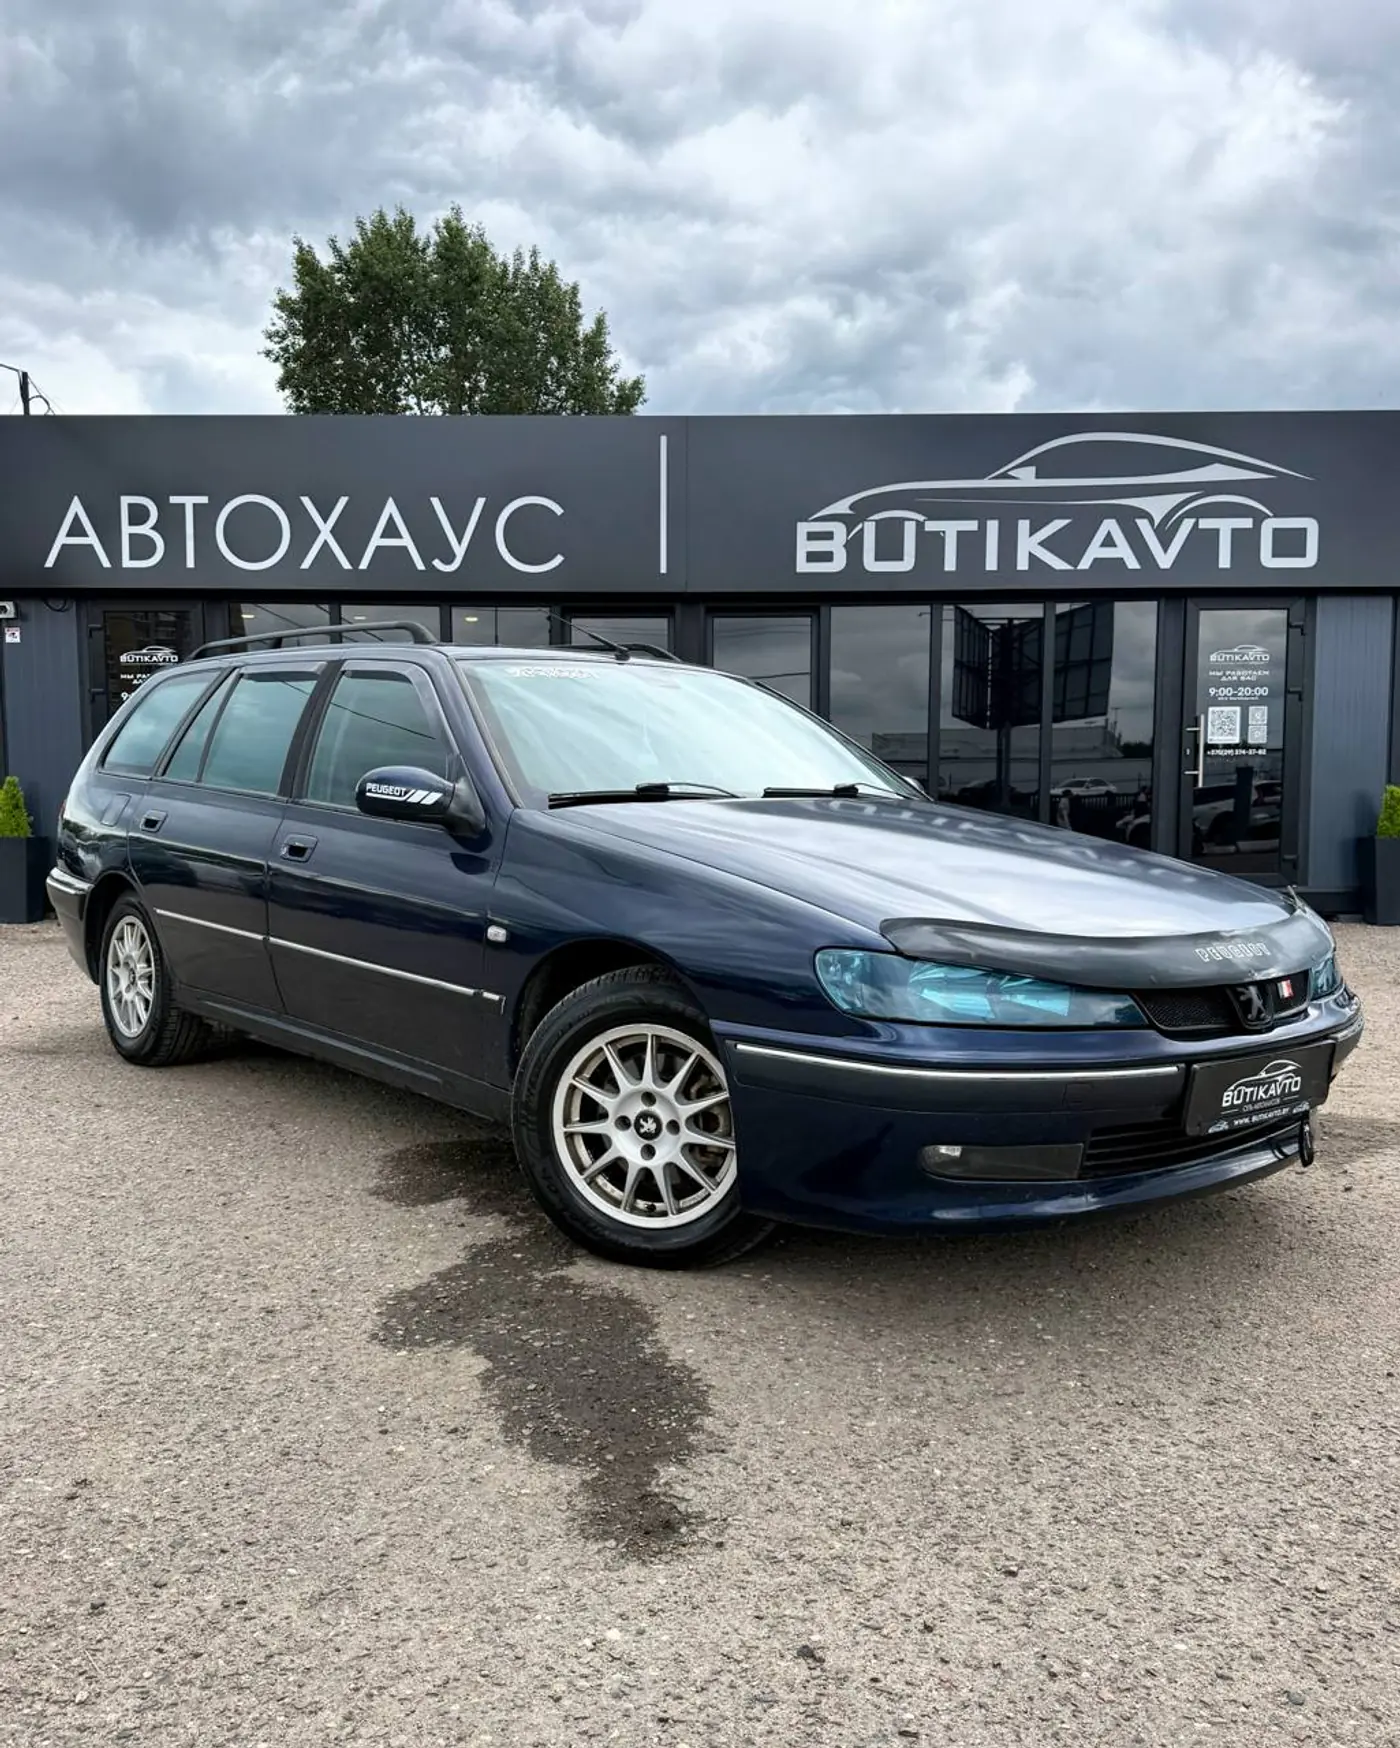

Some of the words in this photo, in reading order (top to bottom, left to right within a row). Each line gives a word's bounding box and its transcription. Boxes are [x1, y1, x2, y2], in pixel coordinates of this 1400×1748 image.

[44, 494, 565, 574] АВТОХАУС
[796, 515, 1319, 574] BUTIKAVTO
[120, 655, 178, 663] BUTIKAVTO
[1209, 653, 1270, 662] BUTIKAVTO
[1208, 686, 1269, 697] 9:00-20:00
[366, 783, 407, 796] PEUGEOT
[1195, 942, 1271, 962] PEUGEOT
[1221, 1076, 1302, 1108] BUTIKAVTO
